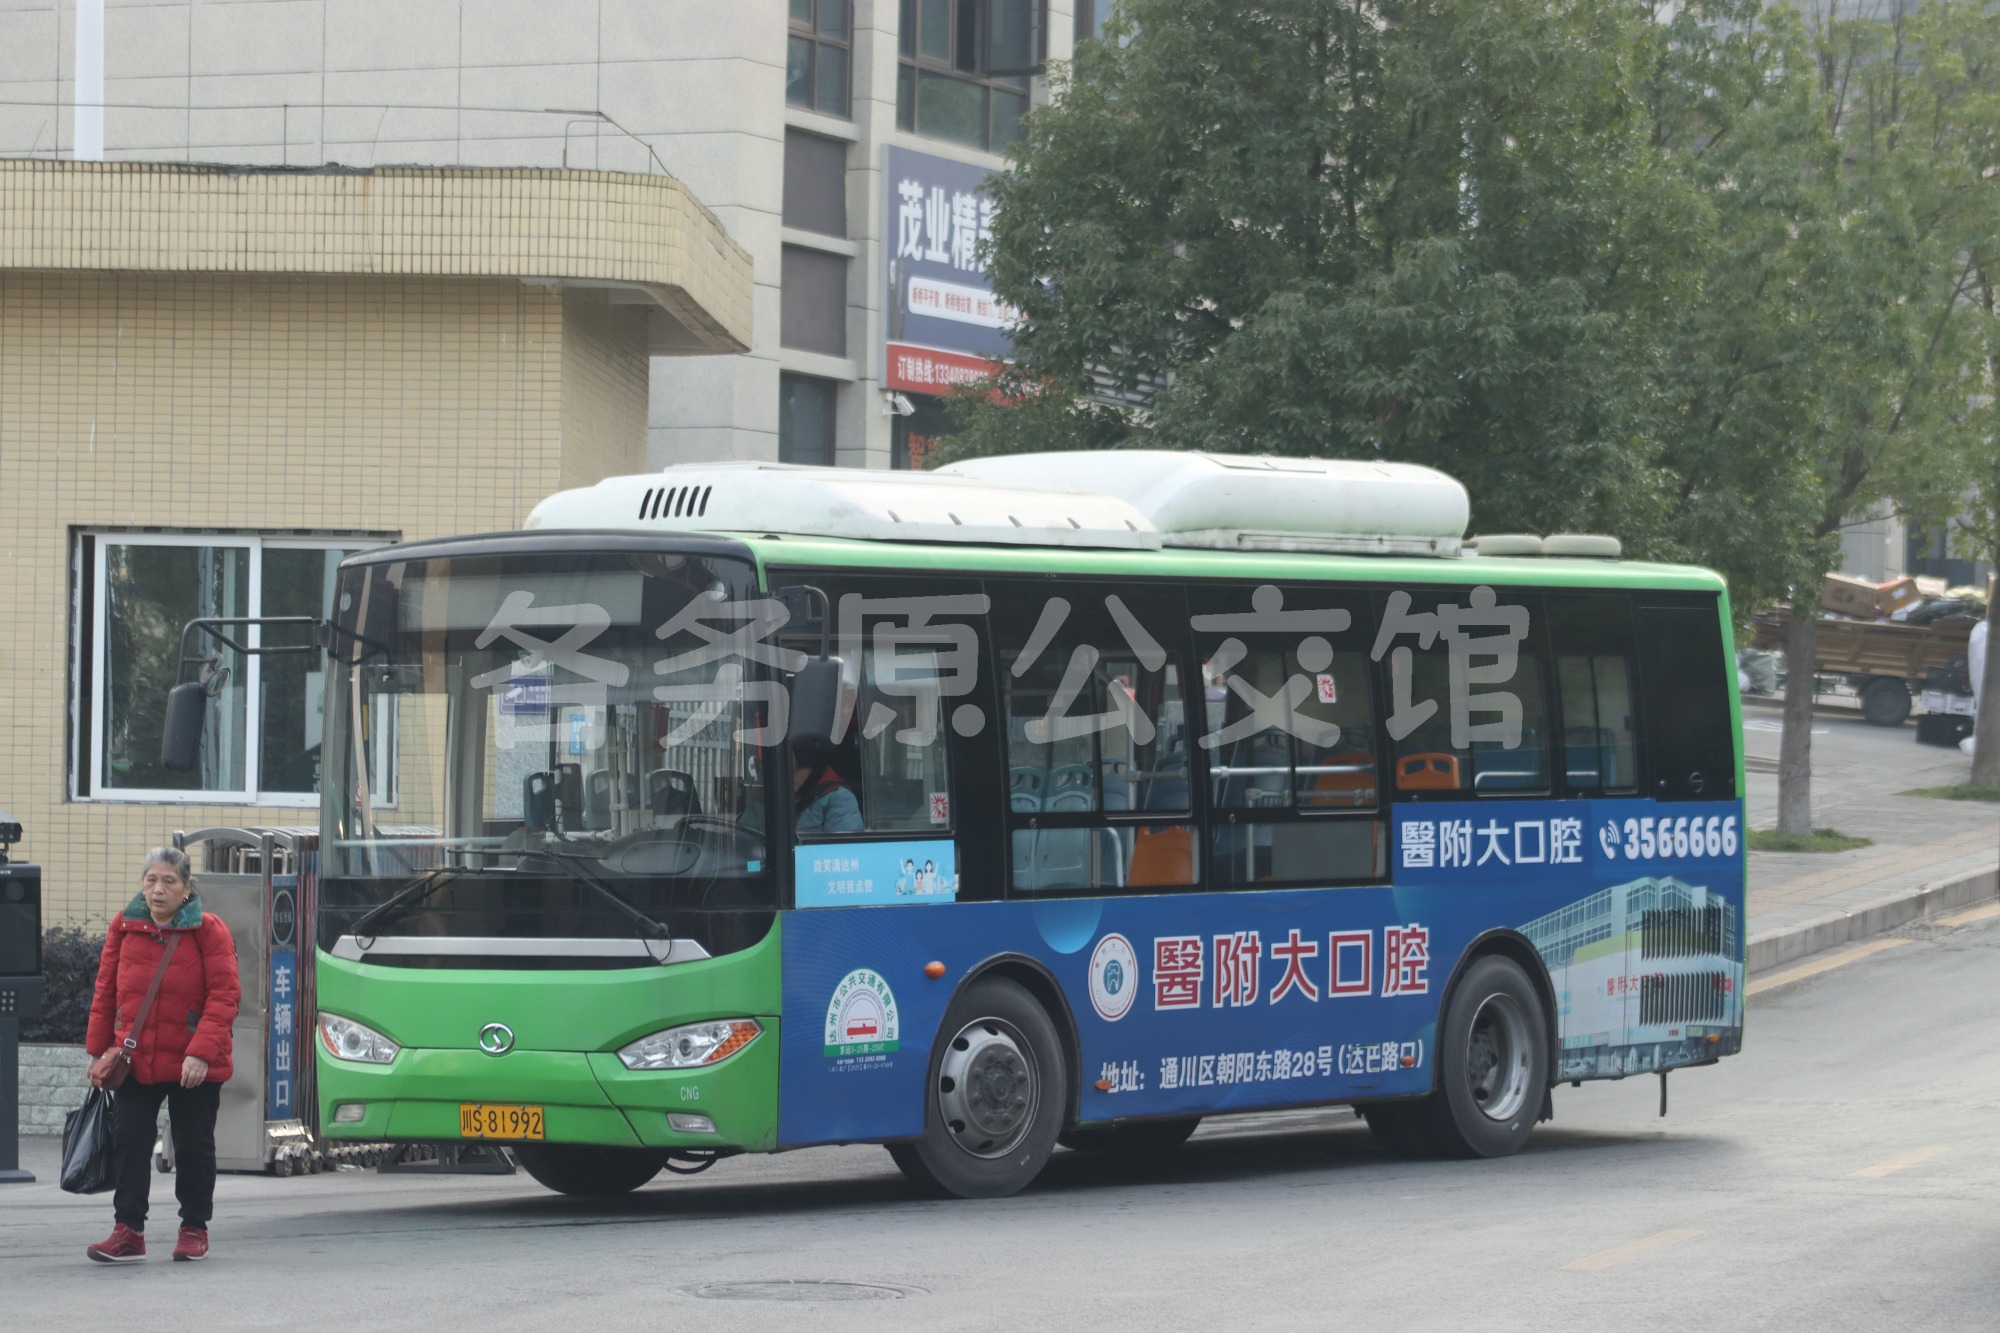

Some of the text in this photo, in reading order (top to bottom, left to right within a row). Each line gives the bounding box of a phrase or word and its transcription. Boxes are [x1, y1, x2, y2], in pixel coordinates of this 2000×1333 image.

[1401, 819, 1583, 868] 醫附大口腔
[1623, 816, 1737, 860] 3566666
[1153, 923, 1430, 1011] 醫附大口腔
[274, 965, 292, 1107] 车辆出口
[680, 1086, 699, 1101] CNG
